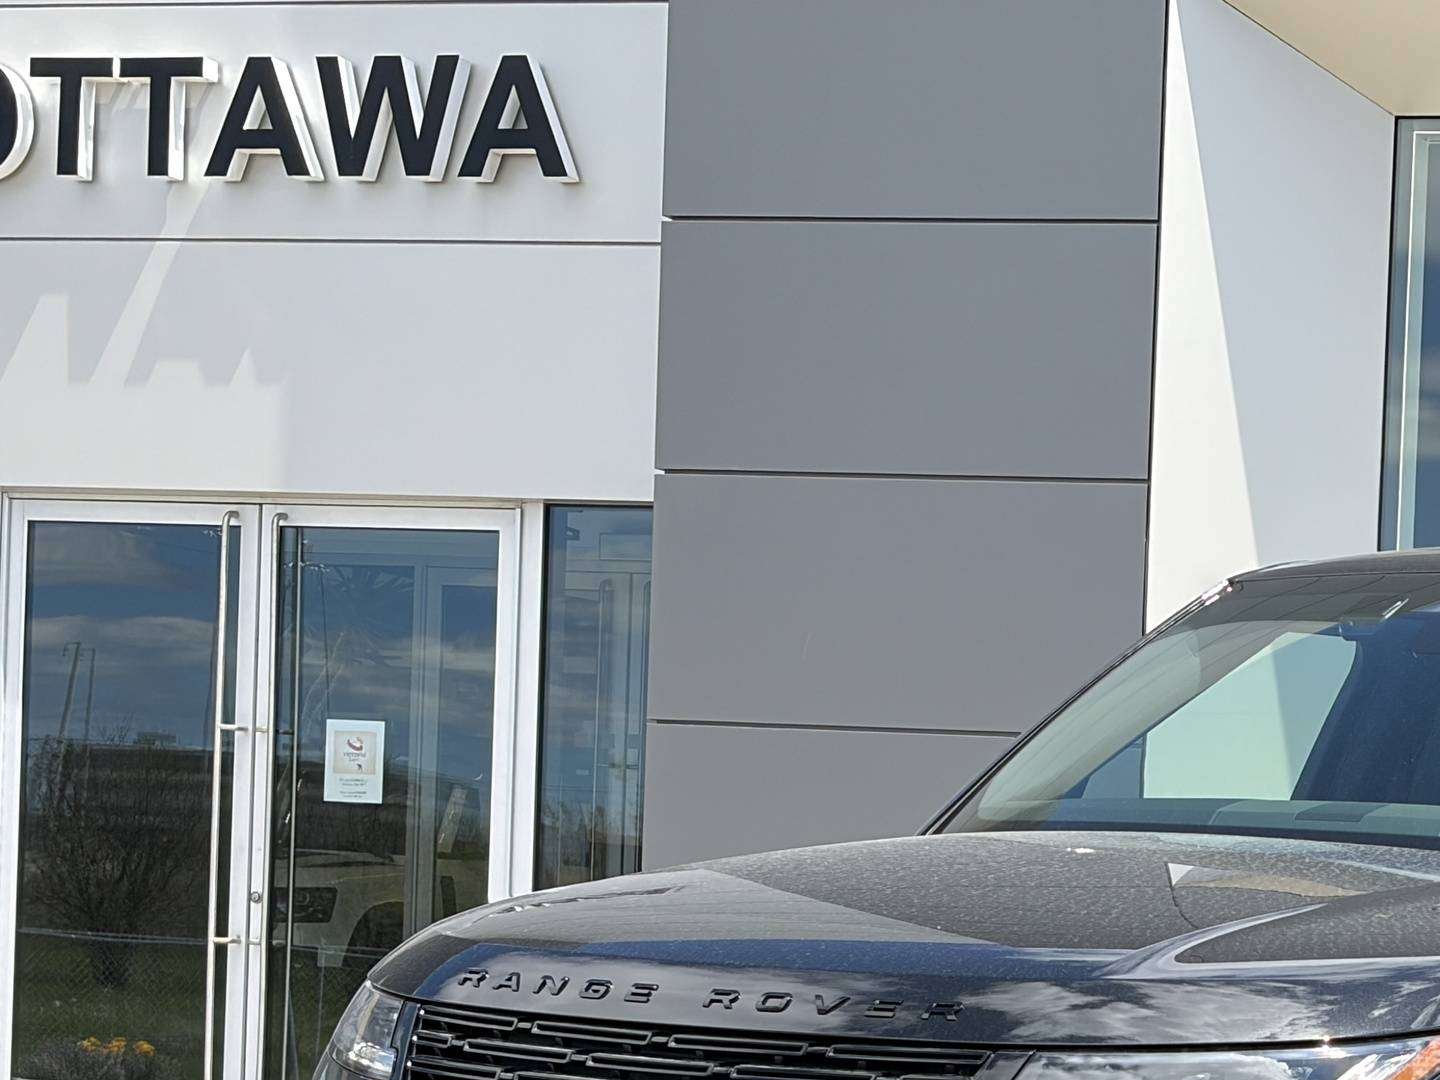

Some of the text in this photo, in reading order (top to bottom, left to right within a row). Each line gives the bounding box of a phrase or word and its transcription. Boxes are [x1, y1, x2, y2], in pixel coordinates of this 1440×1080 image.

[0, 54, 572, 180] TTAWA
[457, 968, 967, 1022] RANGE ROVER
